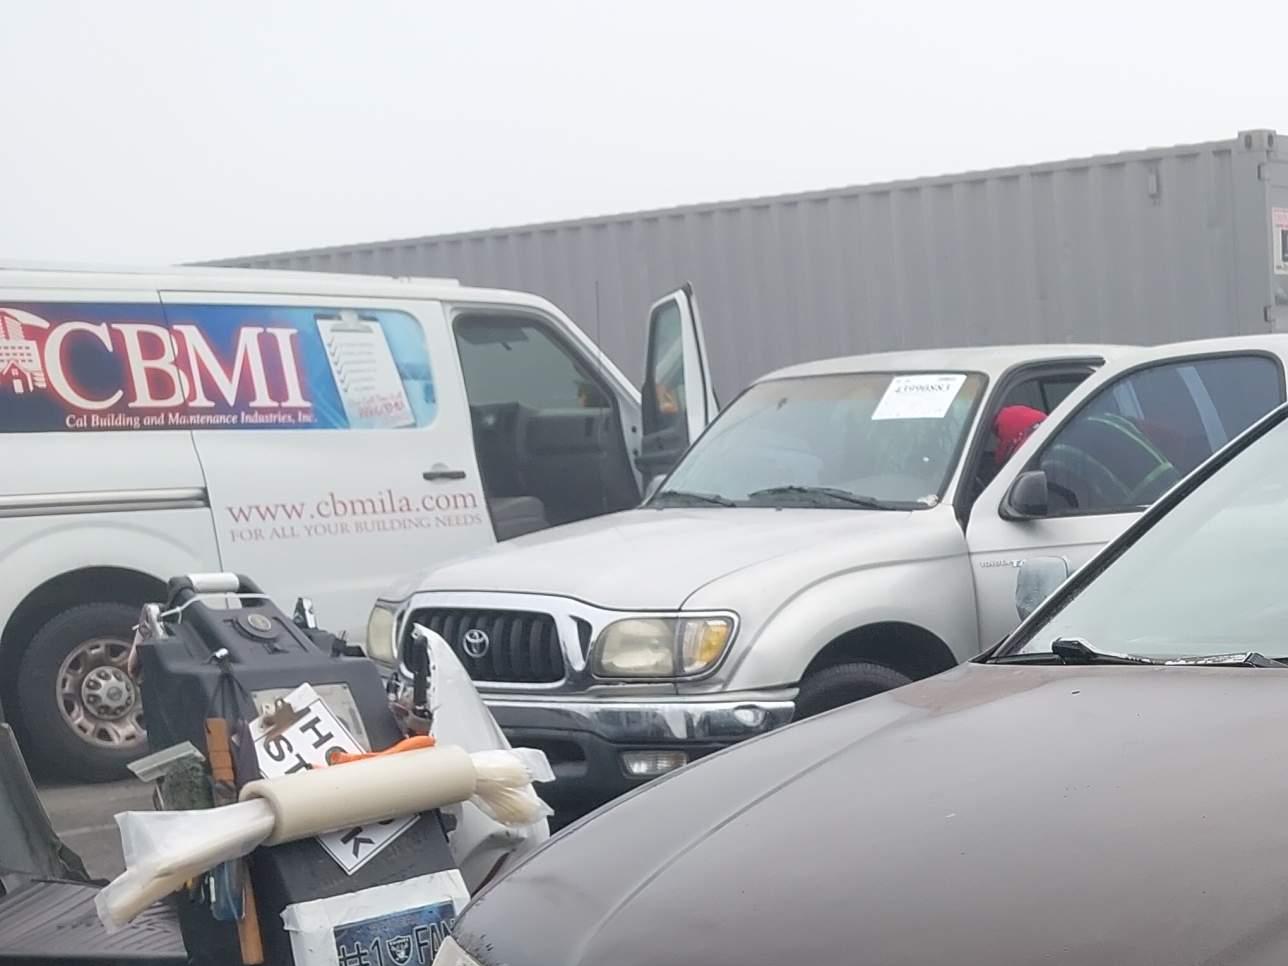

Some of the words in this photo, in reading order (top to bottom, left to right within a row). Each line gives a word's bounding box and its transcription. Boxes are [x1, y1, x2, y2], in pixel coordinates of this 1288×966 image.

[44, 321, 313, 410] CBMI
[66, 413, 87, 428] Cal
[91, 412, 140, 428] Building
[143, 412, 165, 425] and
[241, 411, 295, 425] Industries,
[226, 489, 478, 524] www.cbmila.com
[230, 528, 264, 543] FOR
[269, 526, 300, 540] ALL
[304, 523, 351, 537] YOUR
[354, 517, 431, 533] BUILDING
[435, 514, 483, 528] NEEDS
